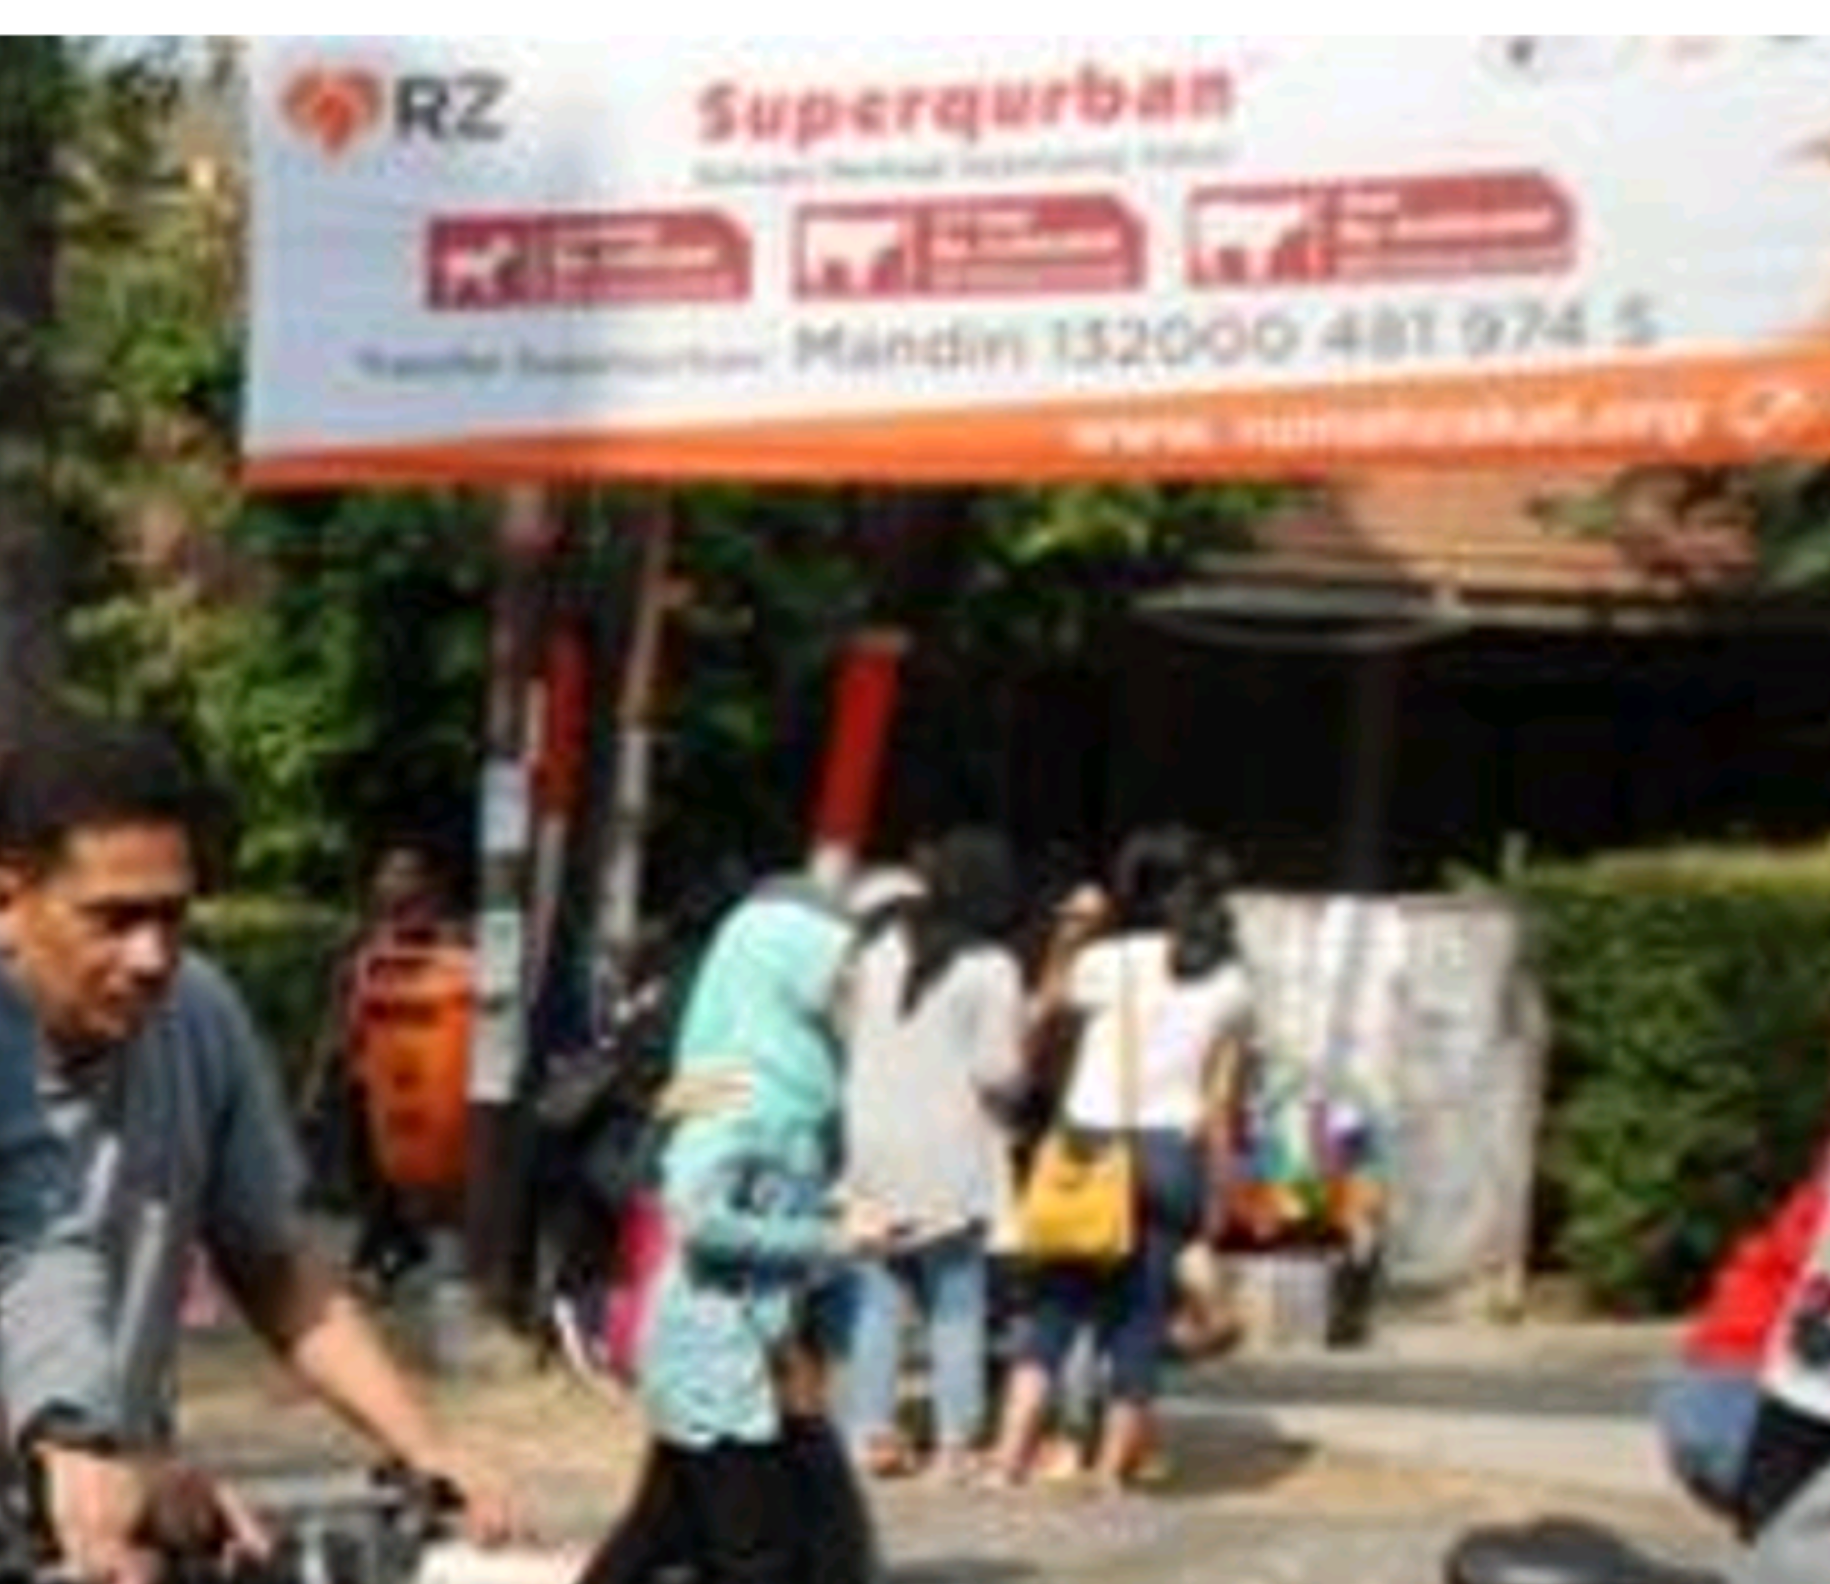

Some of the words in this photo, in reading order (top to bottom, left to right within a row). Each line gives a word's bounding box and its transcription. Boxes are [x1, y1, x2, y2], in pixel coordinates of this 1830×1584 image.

[393, 74, 509, 142] RZ
[695, 62, 1237, 150] Superqurban
[794, 314, 1031, 374] Mandiri
[1051, 308, 1299, 366] 132000
[1459, 300, 1587, 356] 974
